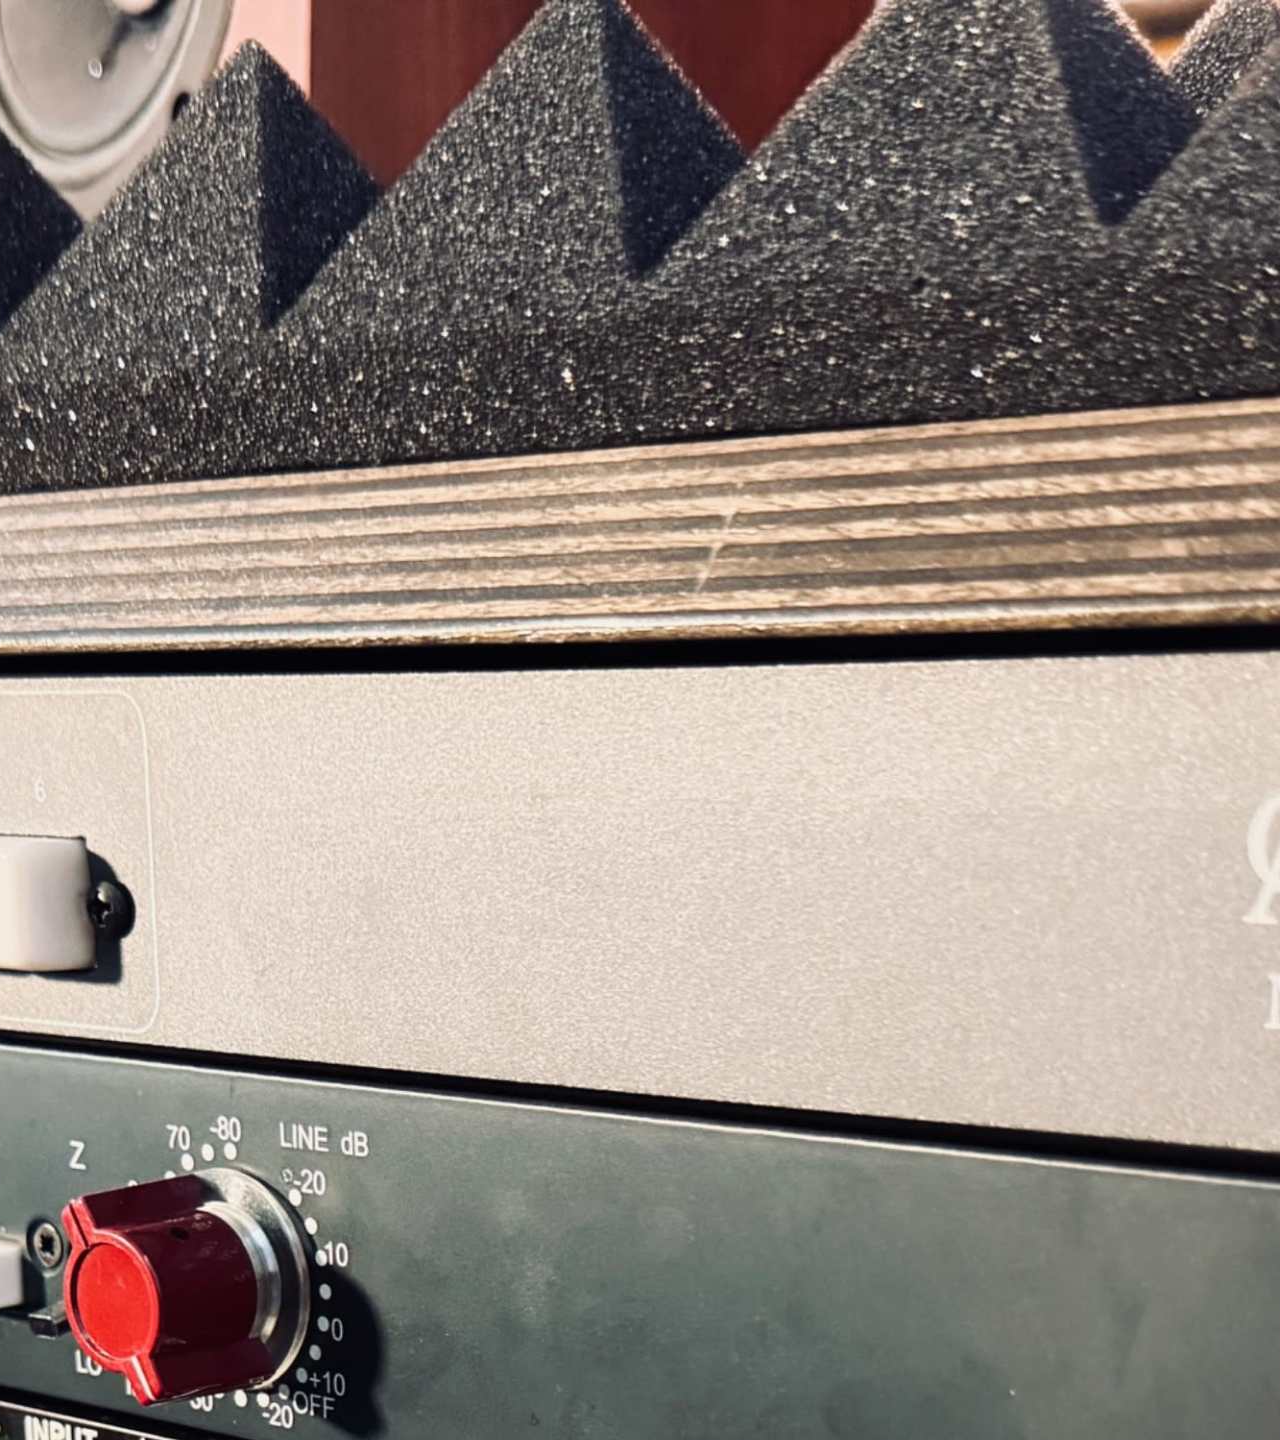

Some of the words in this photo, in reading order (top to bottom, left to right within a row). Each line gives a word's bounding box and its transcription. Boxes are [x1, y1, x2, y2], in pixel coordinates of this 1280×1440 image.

[209, 1116, 241, 1142] -80
[279, 1122, 330, 1153] LINE
[340, 1131, 370, 1158] dB
[69, 1140, 87, 1170] Z
[292, 1169, 326, 1196] -20
[331, 1318, 344, 1342] 0
[309, 1372, 346, 1396] +10
[262, 1403, 294, 1429] -20
[292, 1390, 336, 1419] OFF
